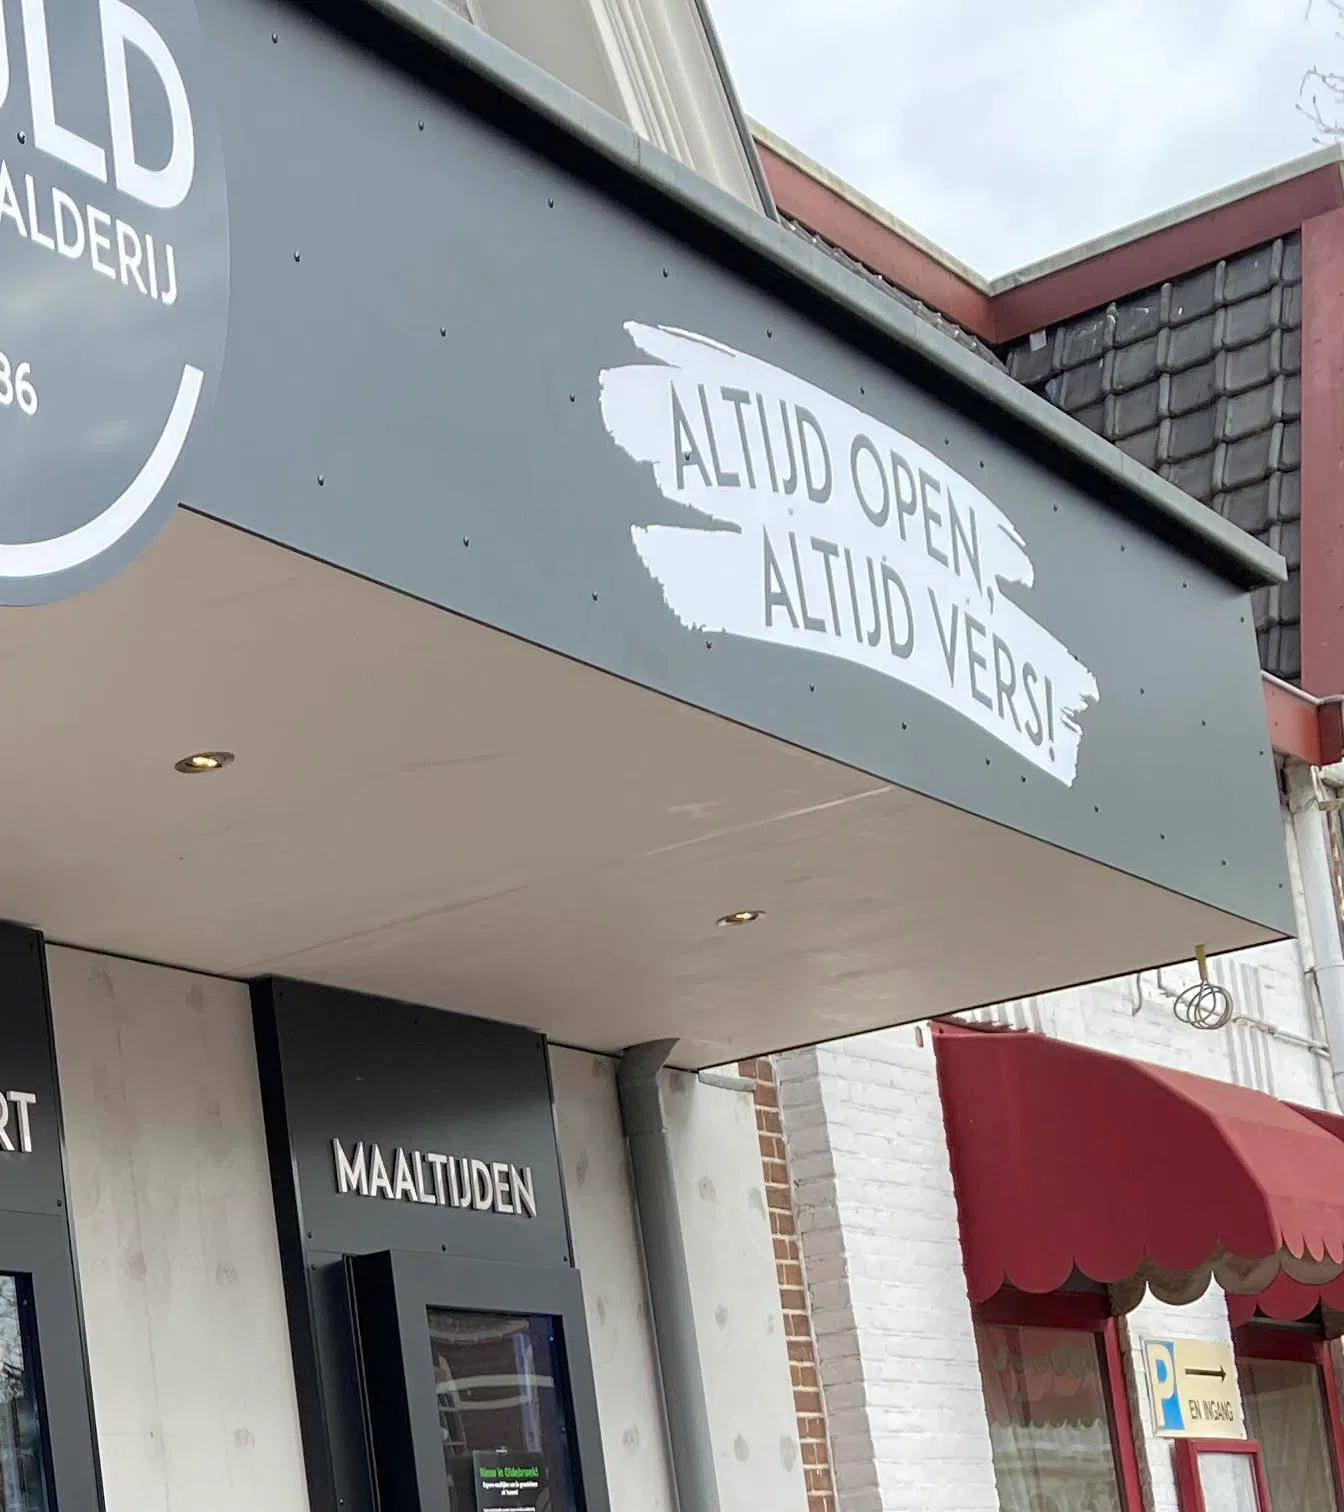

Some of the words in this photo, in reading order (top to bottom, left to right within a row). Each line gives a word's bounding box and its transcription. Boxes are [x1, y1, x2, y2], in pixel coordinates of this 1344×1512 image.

[669, 380, 833, 504] ALTIJD
[849, 433, 997, 614] OPEN,
[763, 524, 914, 660] ALTIJD
[928, 586, 1058, 763] VERS!
[330, 1137, 537, 1217] MAALTIJDEN
[1146, 1343, 1176, 1428] P
[1188, 1400, 1202, 1420] EN
[1202, 1400, 1234, 1422] INGANG
